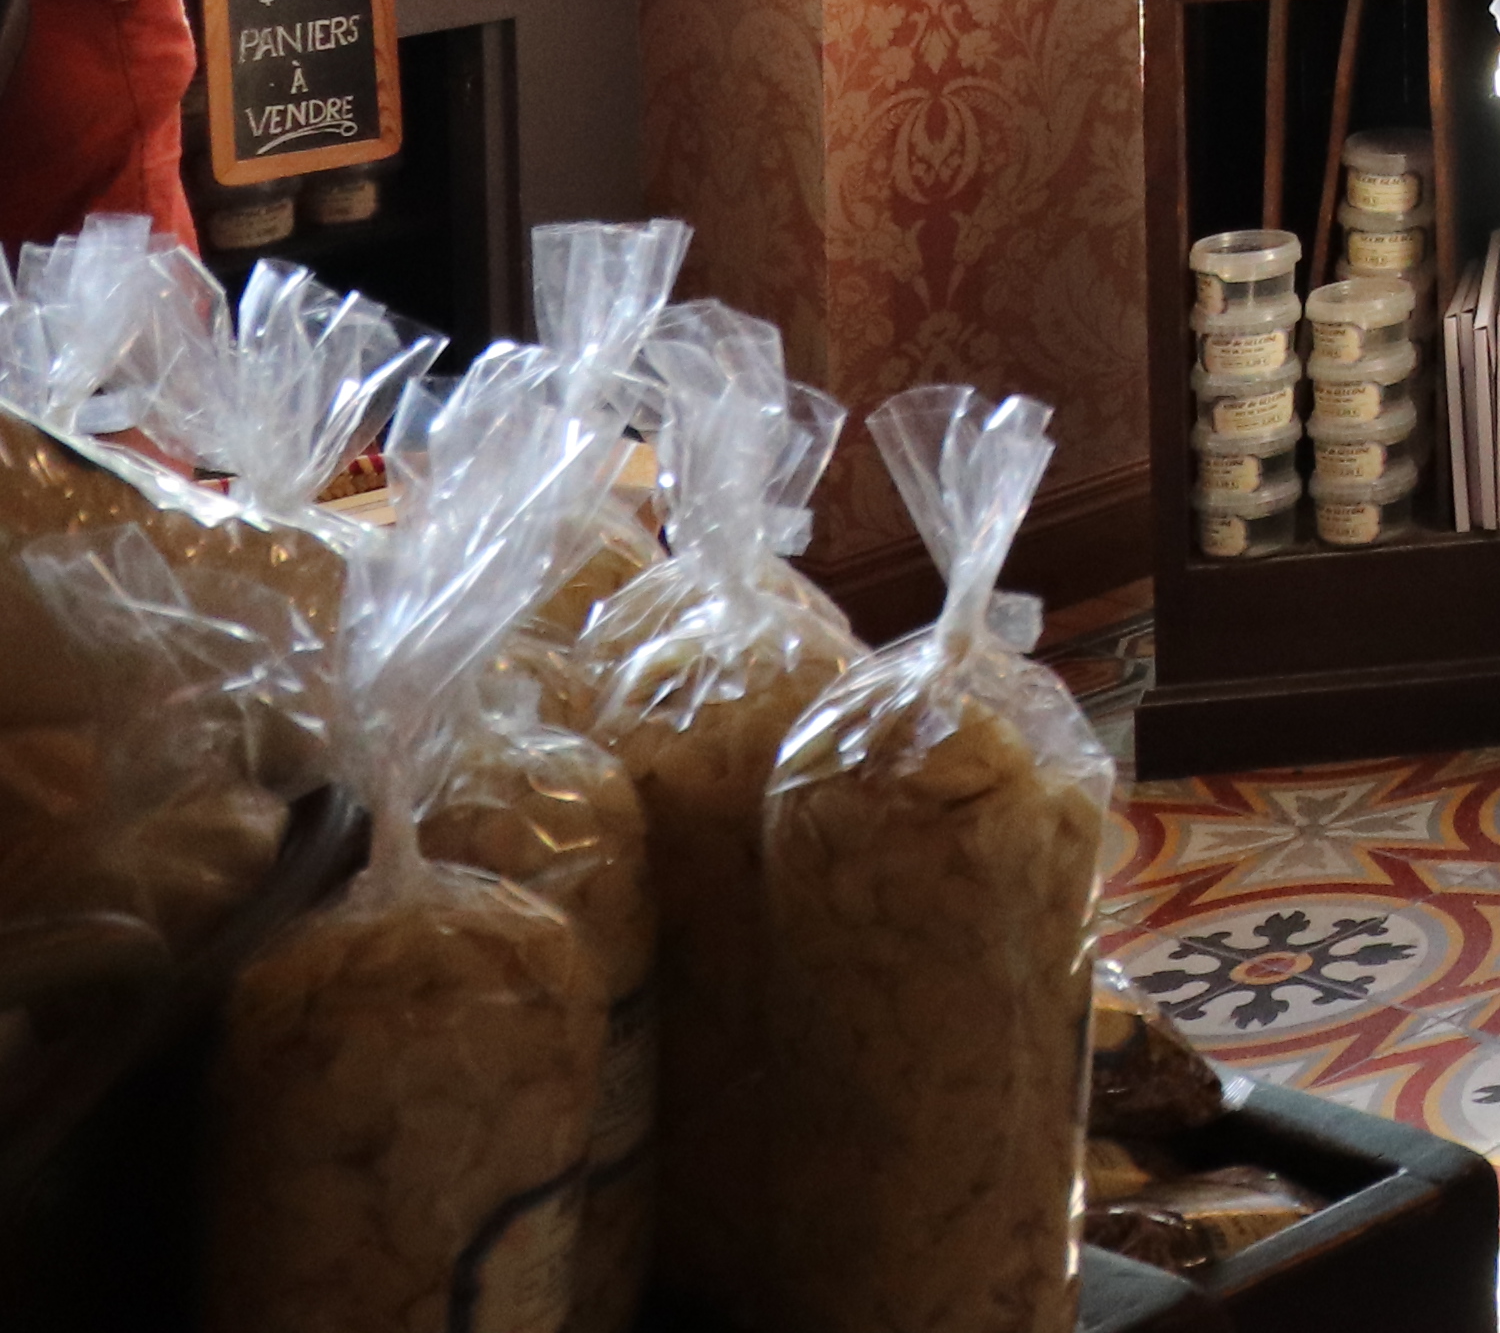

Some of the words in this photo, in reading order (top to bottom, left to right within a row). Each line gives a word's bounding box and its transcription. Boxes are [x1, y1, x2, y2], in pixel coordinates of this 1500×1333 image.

[238, 14, 361, 63] PANIERS
[290, 59, 309, 95] À
[245, 95, 355, 137] VENDRE
